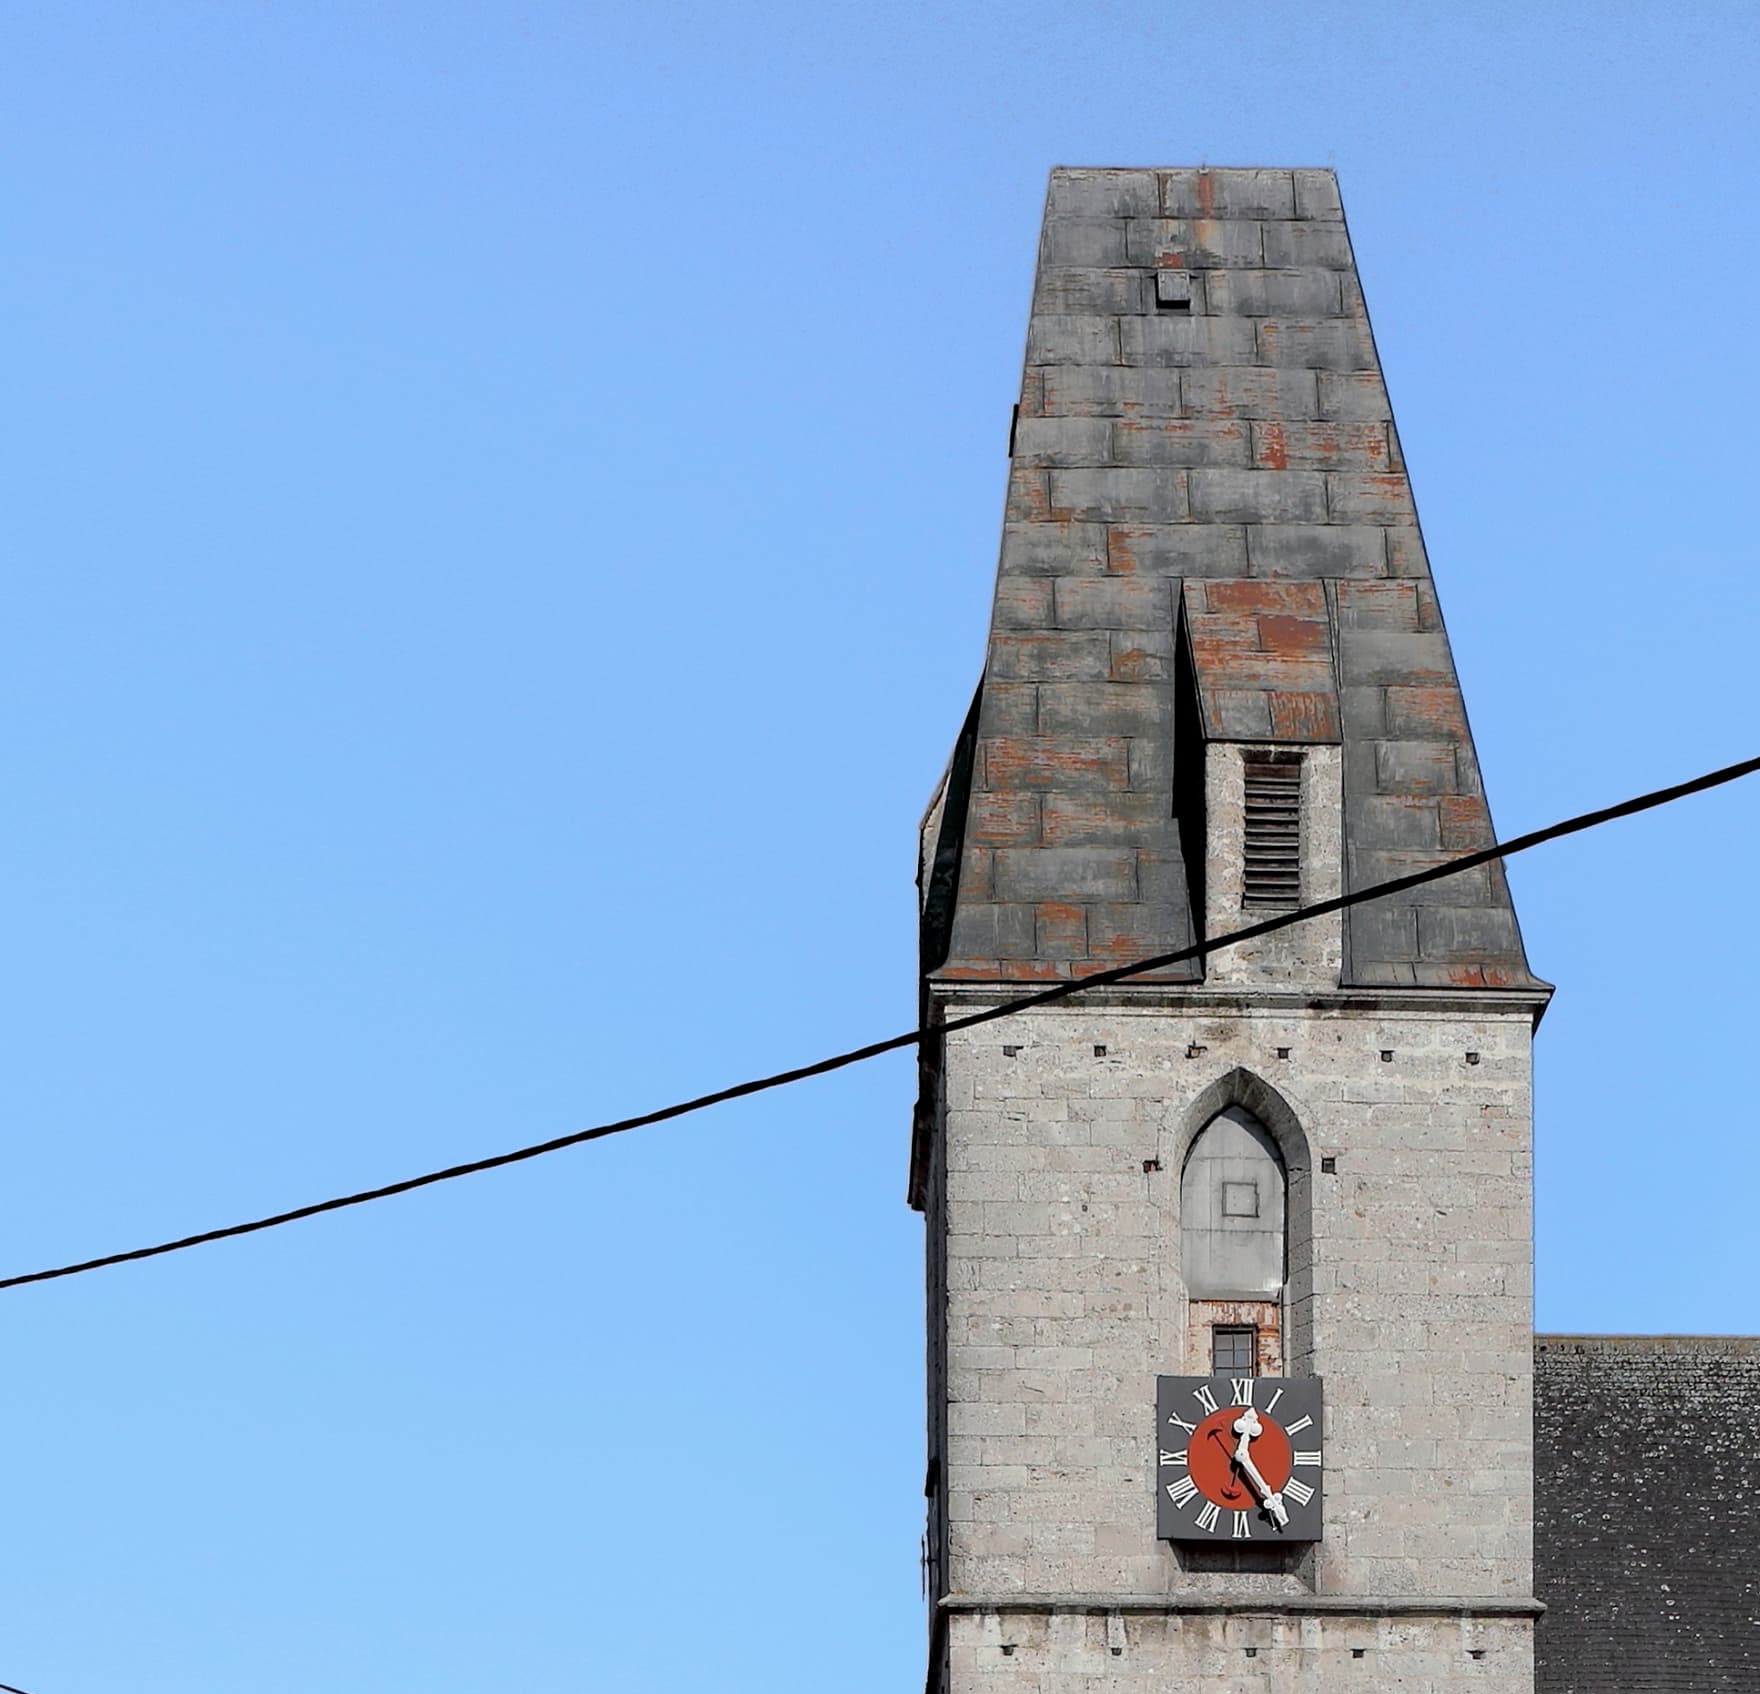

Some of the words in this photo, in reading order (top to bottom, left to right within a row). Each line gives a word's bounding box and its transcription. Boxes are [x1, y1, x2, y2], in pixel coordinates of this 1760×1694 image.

[1193, 1385, 1219, 1416] XI
[1230, 1378, 1254, 1406] XII
[1265, 1388, 1284, 1414] I
[1168, 1412, 1197, 1436] X
[1285, 1414, 1313, 1436] II
[1160, 1449, 1188, 1466] IX
[1293, 1451, 1322, 1466] III
[1166, 1475, 1199, 1510] VIII
[1282, 1476, 1316, 1507] IIII
[1194, 1500, 1221, 1533] VII
[1232, 1510, 1251, 1538] VI
